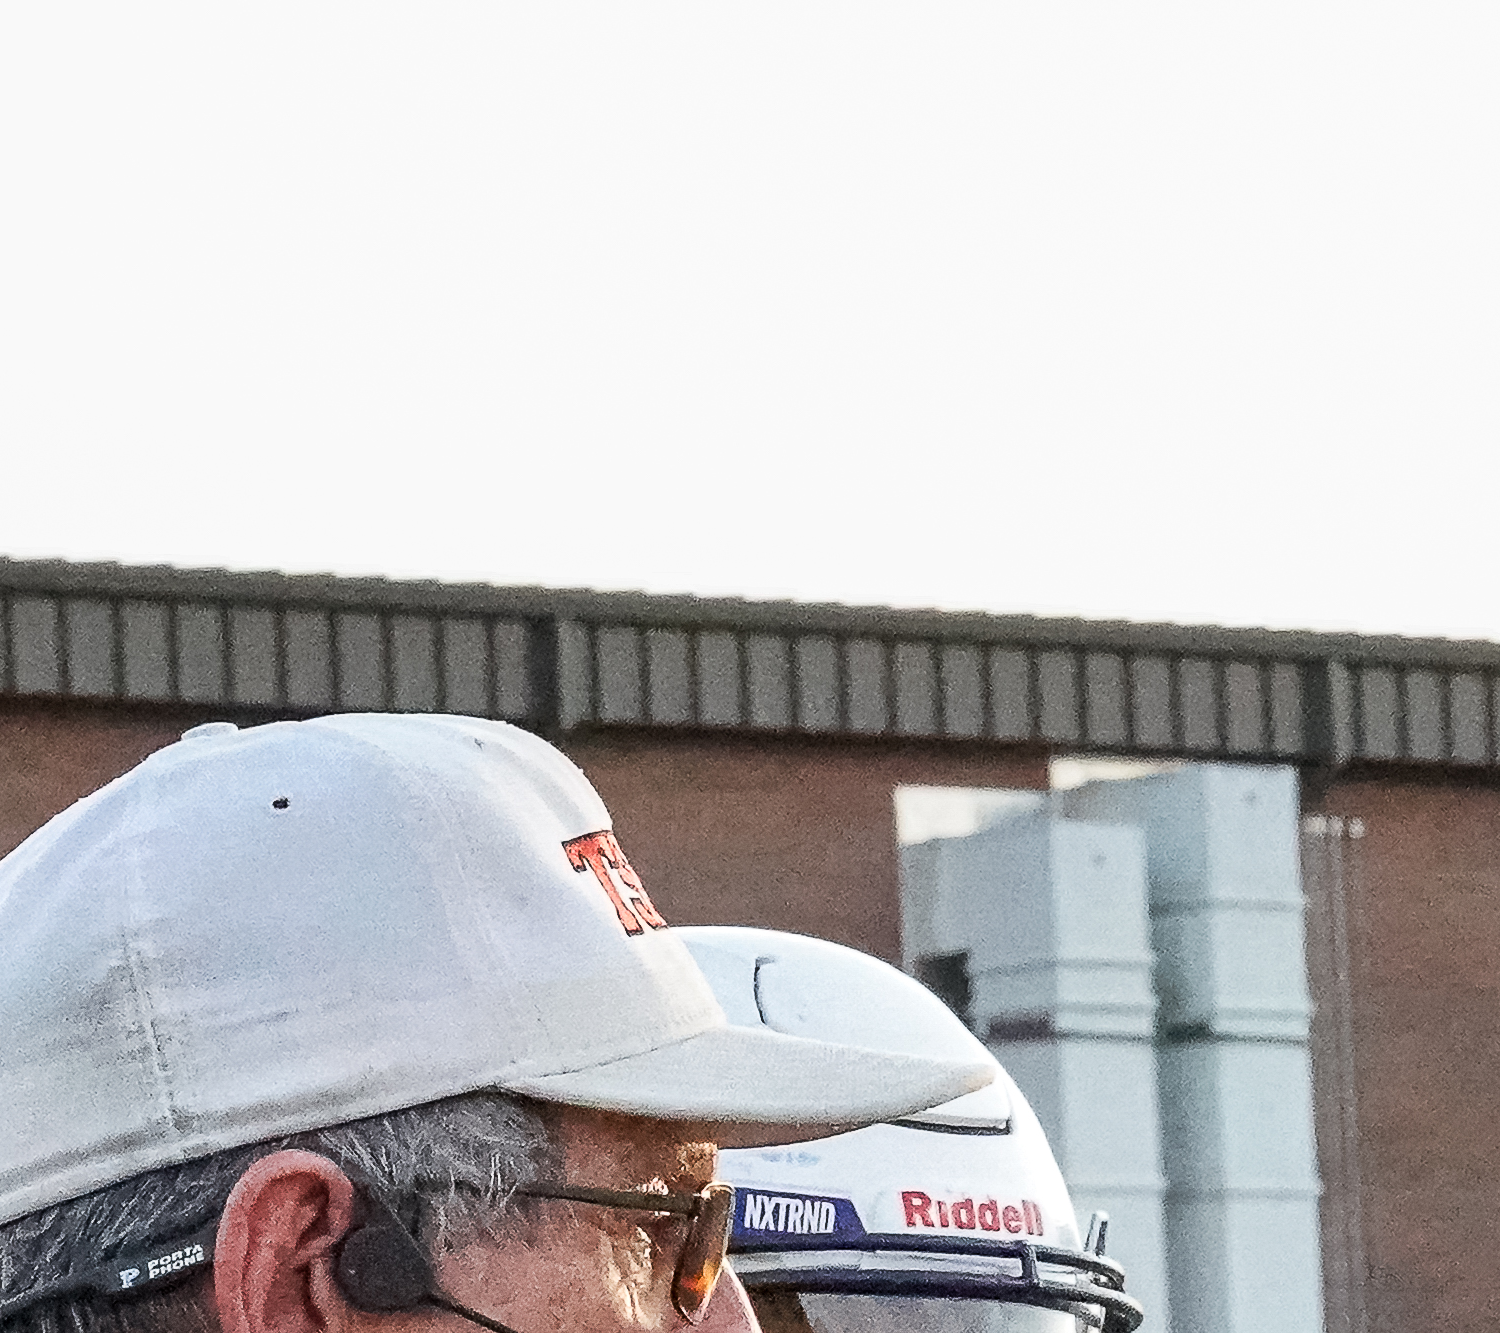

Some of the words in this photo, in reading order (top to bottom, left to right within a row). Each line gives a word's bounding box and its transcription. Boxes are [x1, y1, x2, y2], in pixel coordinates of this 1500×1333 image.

[743, 1193, 837, 1235] NXTRND
[898, 1190, 1045, 1237] Riddell
[146, 1244, 204, 1271] PORTA
[147, 1251, 205, 1279] PHONE
